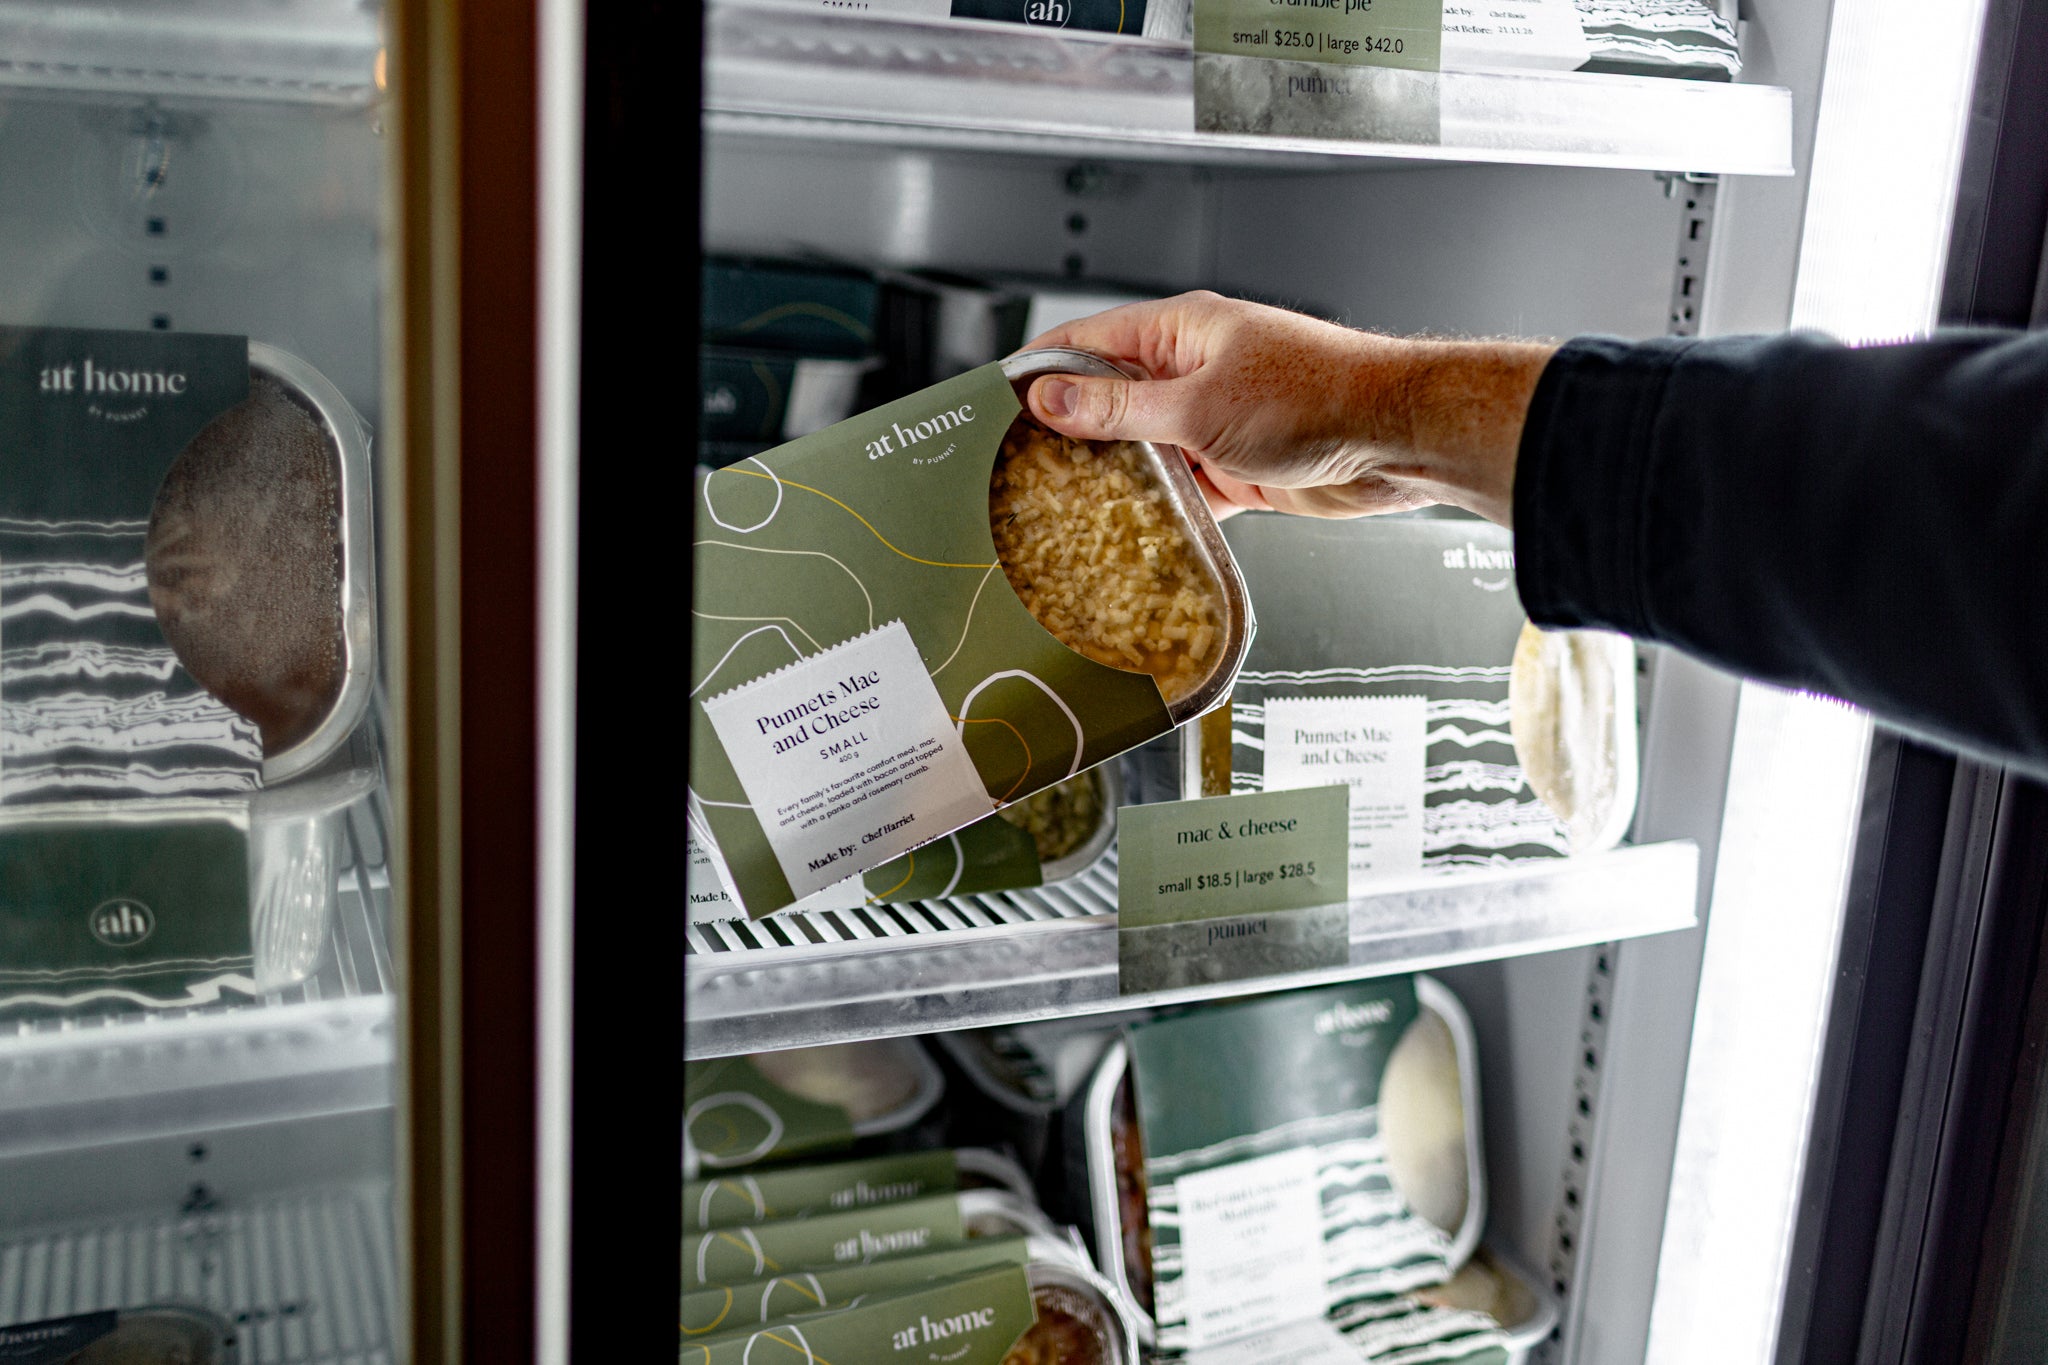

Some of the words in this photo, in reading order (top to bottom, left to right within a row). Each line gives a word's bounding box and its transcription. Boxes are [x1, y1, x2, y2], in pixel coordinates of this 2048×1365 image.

[1029, 0, 1064, 22] ah
[1443, 7, 1459, 15] ade
[1233, 30, 1268, 45] small
[1274, 31, 1314, 48] $25.0
[1327, 34, 1359, 54] large
[1365, 36, 1404, 54] $42.0
[40, 365, 75, 391] at
[84, 359, 187, 394] home
[865, 434, 895, 460] at
[891, 404, 976, 449] home
[927, 443, 957, 465] PUNNET
[1443, 547, 1465, 569] at
[1466, 541, 1515, 569] hom
[756, 690, 837, 735] Punnets
[838, 670, 880, 698] Mac
[772, 725, 810, 754] and
[811, 696, 880, 735] Cheese
[1295, 729, 1357, 745] Punnets
[1361, 727, 1392, 743] Mac
[820, 731, 868, 760] SMALL
[839, 753, 853, 763] 400
[1301, 748, 1329, 765] and
[1333, 748, 1388, 765] Cheese
[777, 802, 799, 816] Every
[800, 787, 830, 804] family's
[830, 771, 865, 790] favourite
[866, 756, 896, 774] comfort
[896, 745, 919, 760] meal,
[919, 737, 936, 749] mac
[779, 814, 796, 827] and
[796, 802, 827, 819] cheese,
[827, 786, 855, 803] loaded
[856, 778, 873, 790] with
[873, 766, 899, 782] bacon
[899, 757, 915, 770] and
[915, 744, 944, 762] topped
[800, 817, 818, 830] with
[826, 802, 851, 819] panko
[852, 793, 868, 805] and
[868, 777, 904, 798] rosemary
[807, 852, 839, 872] Made
[838, 844, 857, 858] by:
[861, 827, 883, 845] Chef
[883, 813, 916, 834] Harriet
[1177, 828, 1213, 844] mac
[1218, 821, 1233, 840] &
[1239, 818, 1297, 837] cheese
[1158, 877, 1192, 895] small
[1197, 871, 1232, 890] $18.5
[1243, 869, 1275, 885] large
[1279, 860, 1316, 880] $28.5
[690, 893, 719, 904] Made
[99, 906, 146, 935] ah
[1208, 918, 1267, 946] punnet
[861, 1228, 930, 1255] home
[892, 1326, 918, 1350] at
[920, 1307, 995, 1343] home
